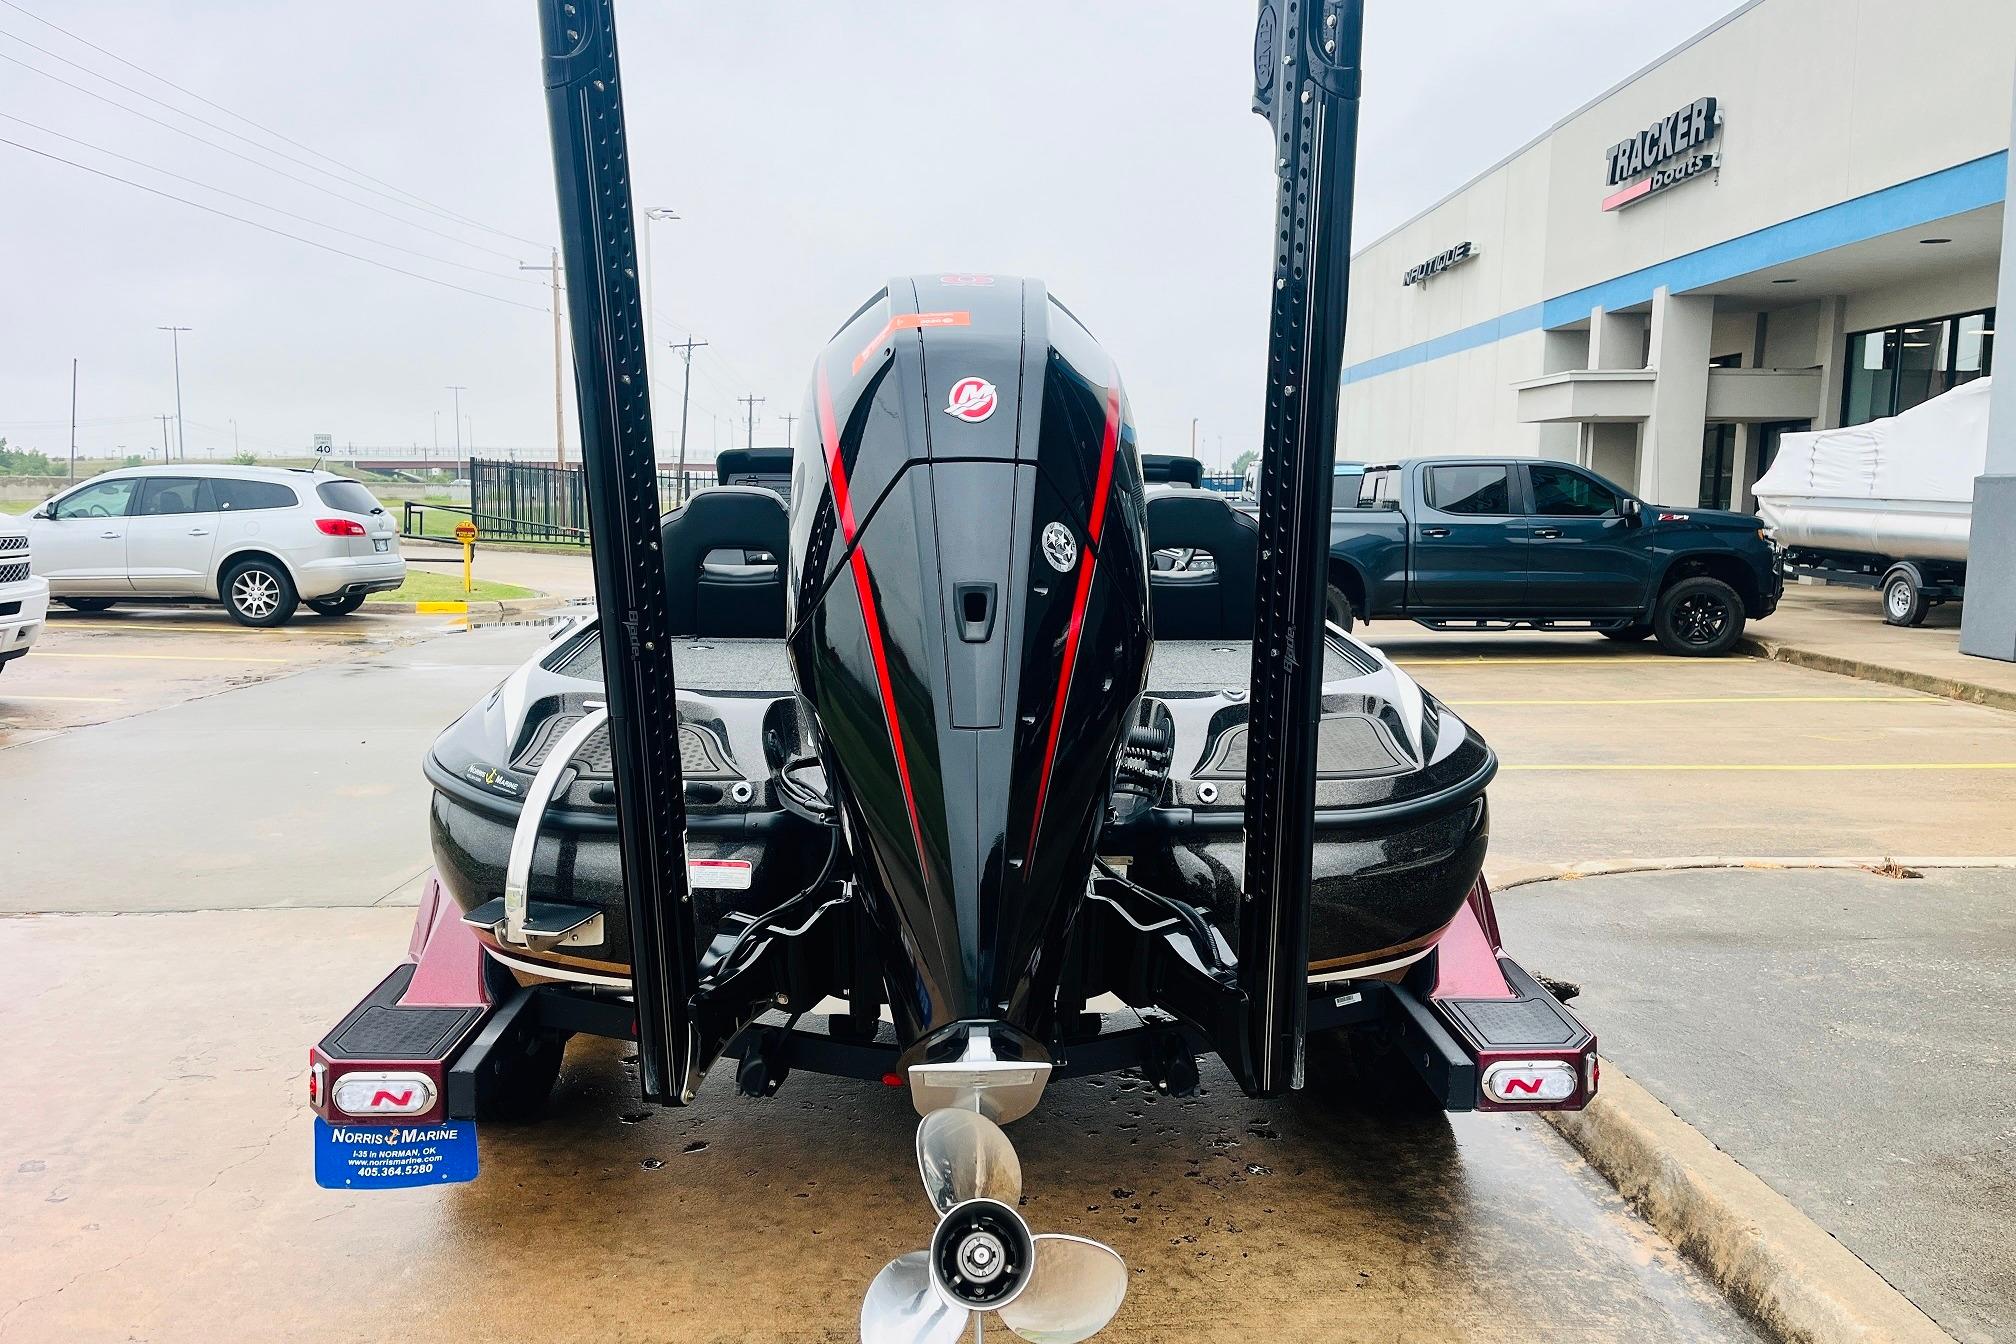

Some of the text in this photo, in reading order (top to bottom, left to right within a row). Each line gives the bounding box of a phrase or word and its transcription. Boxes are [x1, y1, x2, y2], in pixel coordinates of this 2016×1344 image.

[1606, 97, 1713, 186] TRACKER
[1652, 154, 1707, 190] boats
[1403, 242, 1470, 286] NAUTIQUE
[316, 445, 331, 454] 40
[468, 765, 486, 777] NORRIS
[495, 775, 518, 790] MARINE
[332, 1128, 458, 1144] NORRIS MARINE
[348, 1155, 443, 1166] www.norrismarine.com
[353, 1150, 368, 1158] I-35
[378, 1149, 421, 1158] NORMAN,
[422, 1147, 436, 1155] OK
[357, 1163, 433, 1177] 405.364.5280
